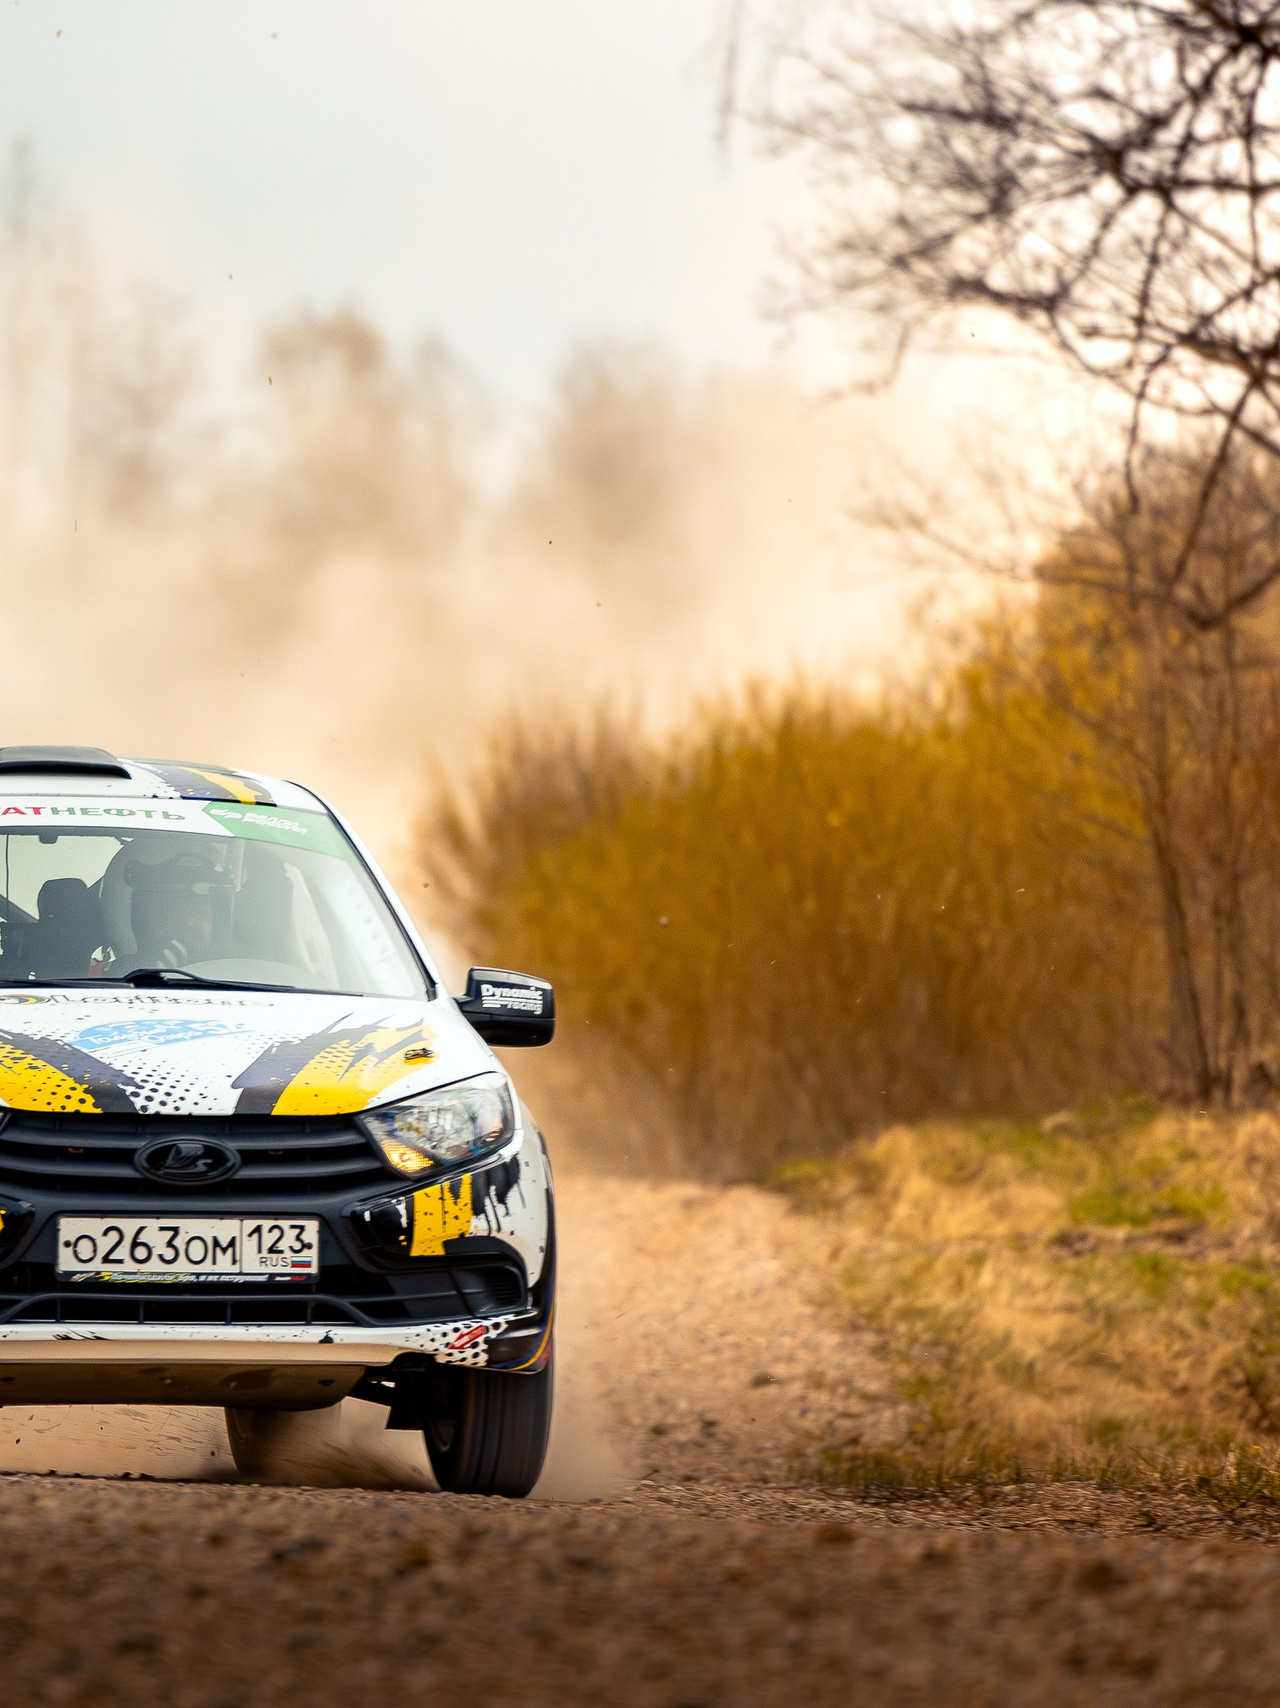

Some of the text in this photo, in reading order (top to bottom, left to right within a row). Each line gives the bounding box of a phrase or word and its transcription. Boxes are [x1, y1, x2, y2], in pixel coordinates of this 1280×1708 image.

[480, 984, 543, 1000] Dynamic
[506, 1002, 543, 1015] racing
[247, 1224, 307, 1254] 123
[259, 1256, 290, 1268] RUS
